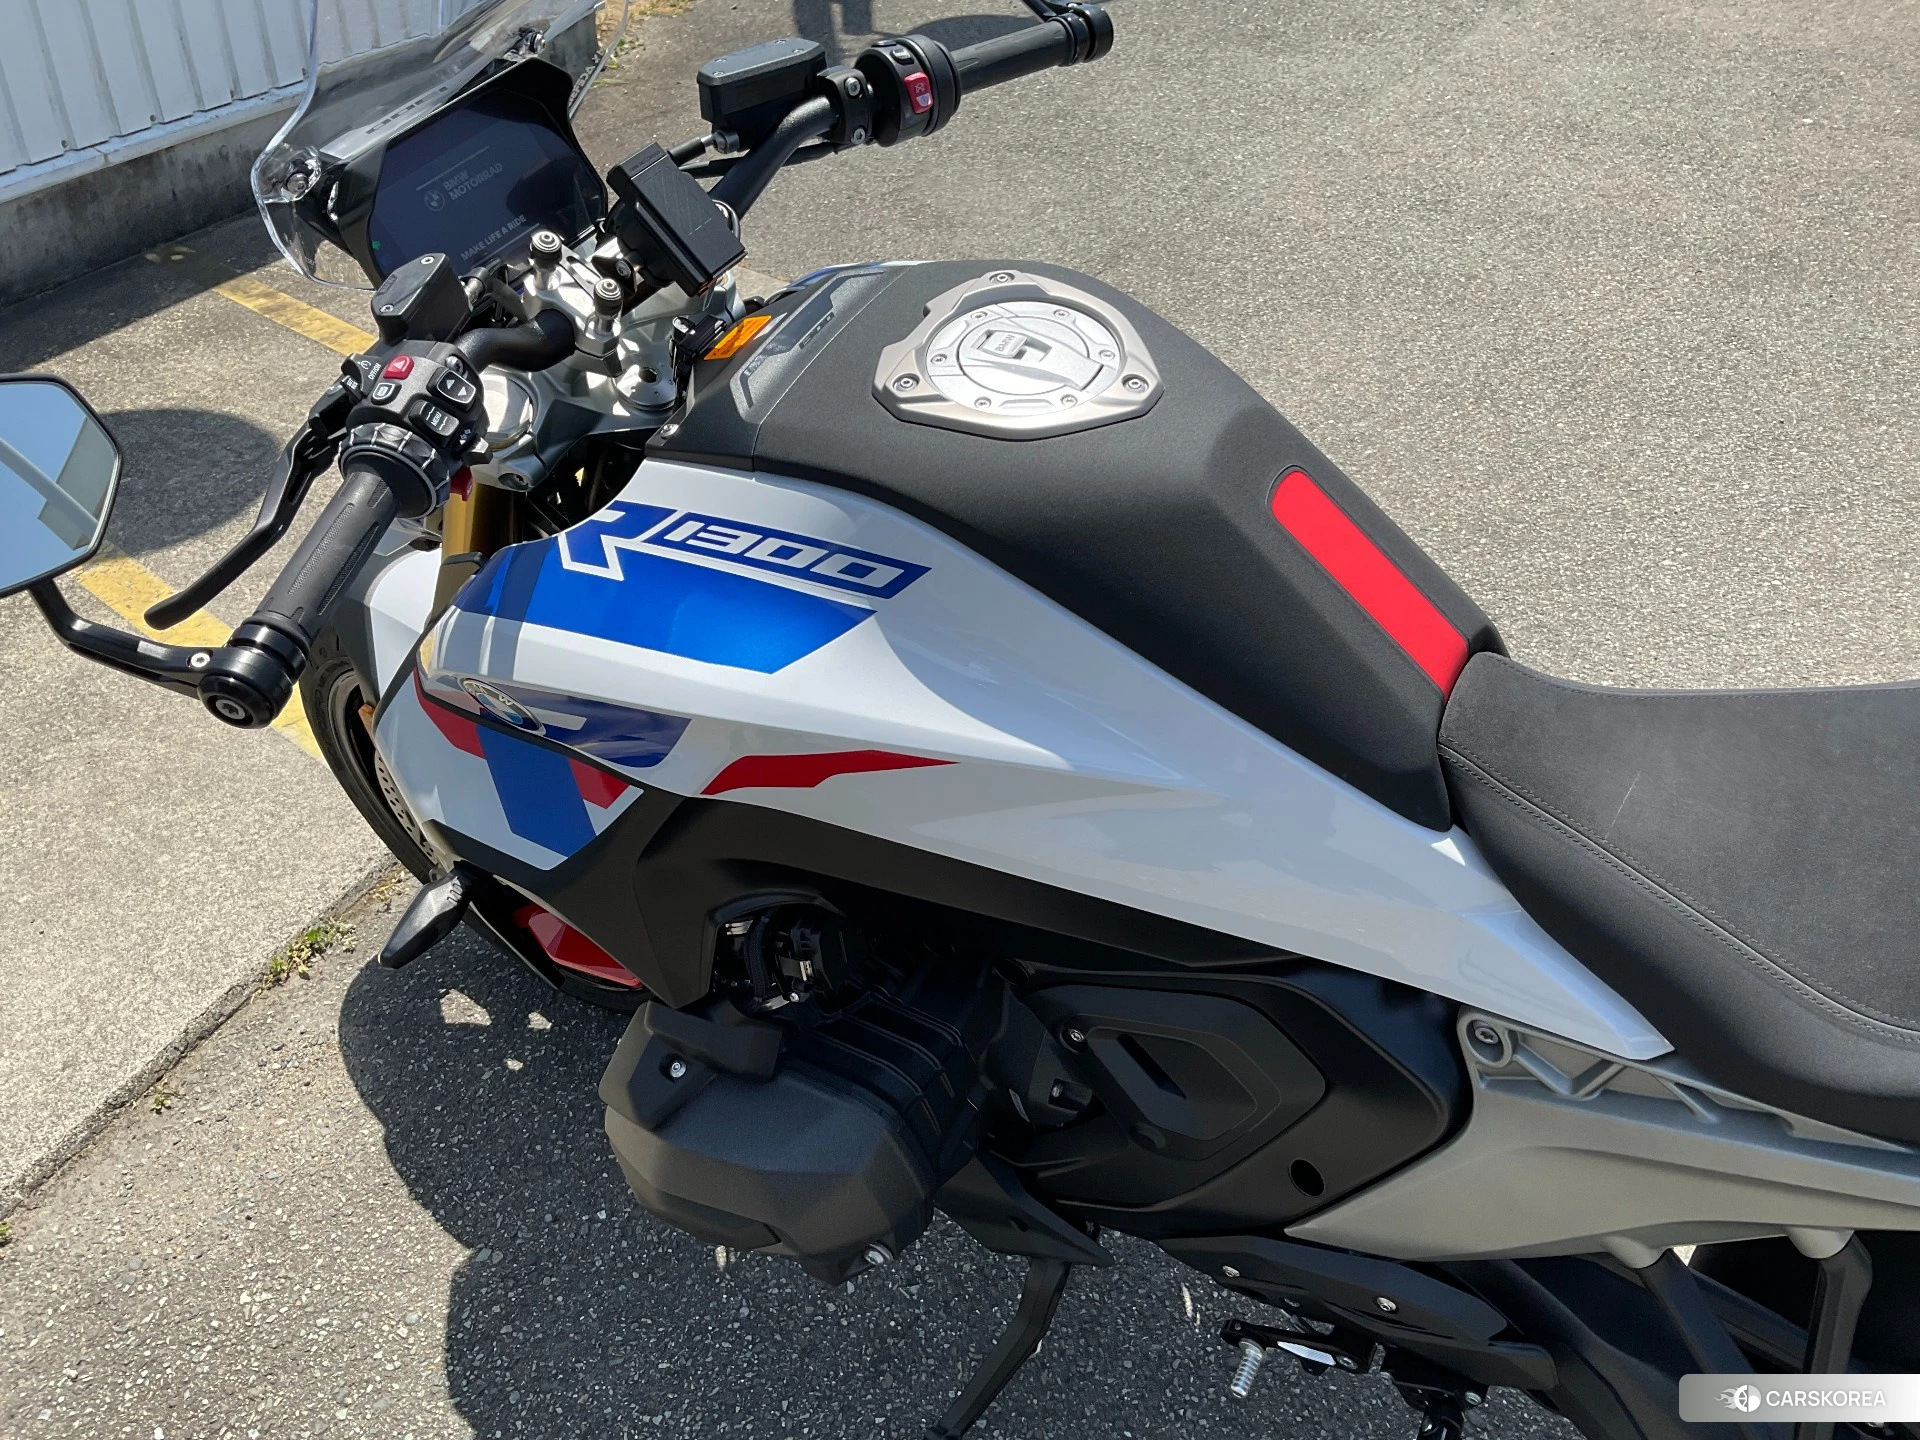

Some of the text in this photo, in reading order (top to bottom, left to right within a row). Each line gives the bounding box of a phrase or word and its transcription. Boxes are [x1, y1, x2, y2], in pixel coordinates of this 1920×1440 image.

[442, 169, 469, 191] BMW
[448, 162, 503, 200] MOTORRAD
[461, 242, 486, 260] MAKE
[484, 230, 502, 245] LIFE
[507, 214, 527, 231] RIDE
[994, 334, 1016, 352] BMW
[664, 520, 905, 589] 1300
